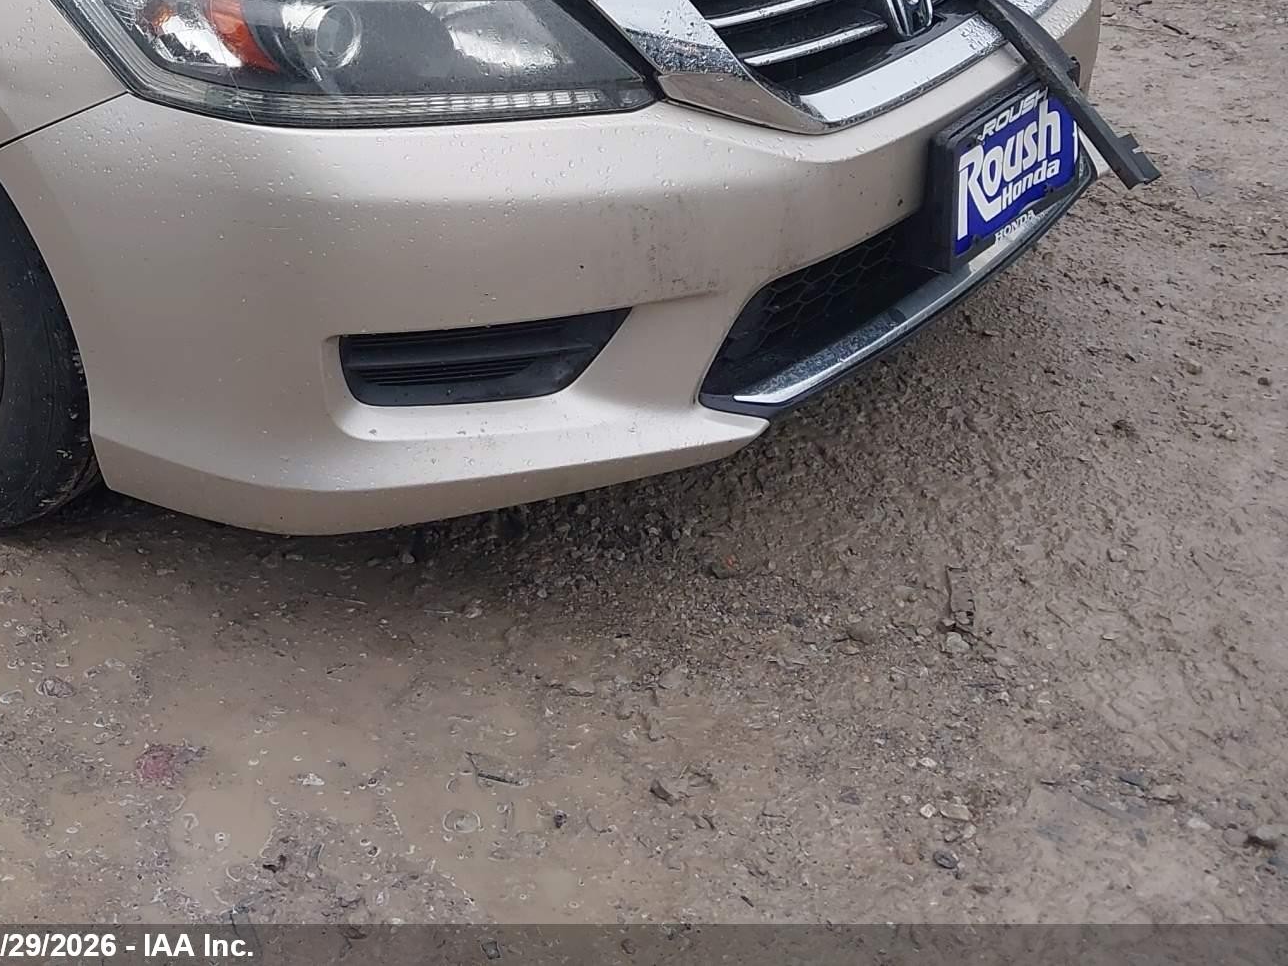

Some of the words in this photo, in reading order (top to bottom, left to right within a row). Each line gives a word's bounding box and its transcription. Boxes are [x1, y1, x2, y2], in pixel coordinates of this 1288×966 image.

[956, 98, 1062, 241] Roush
[1000, 158, 1061, 211] Honda
[994, 209, 1041, 245] HONDA
